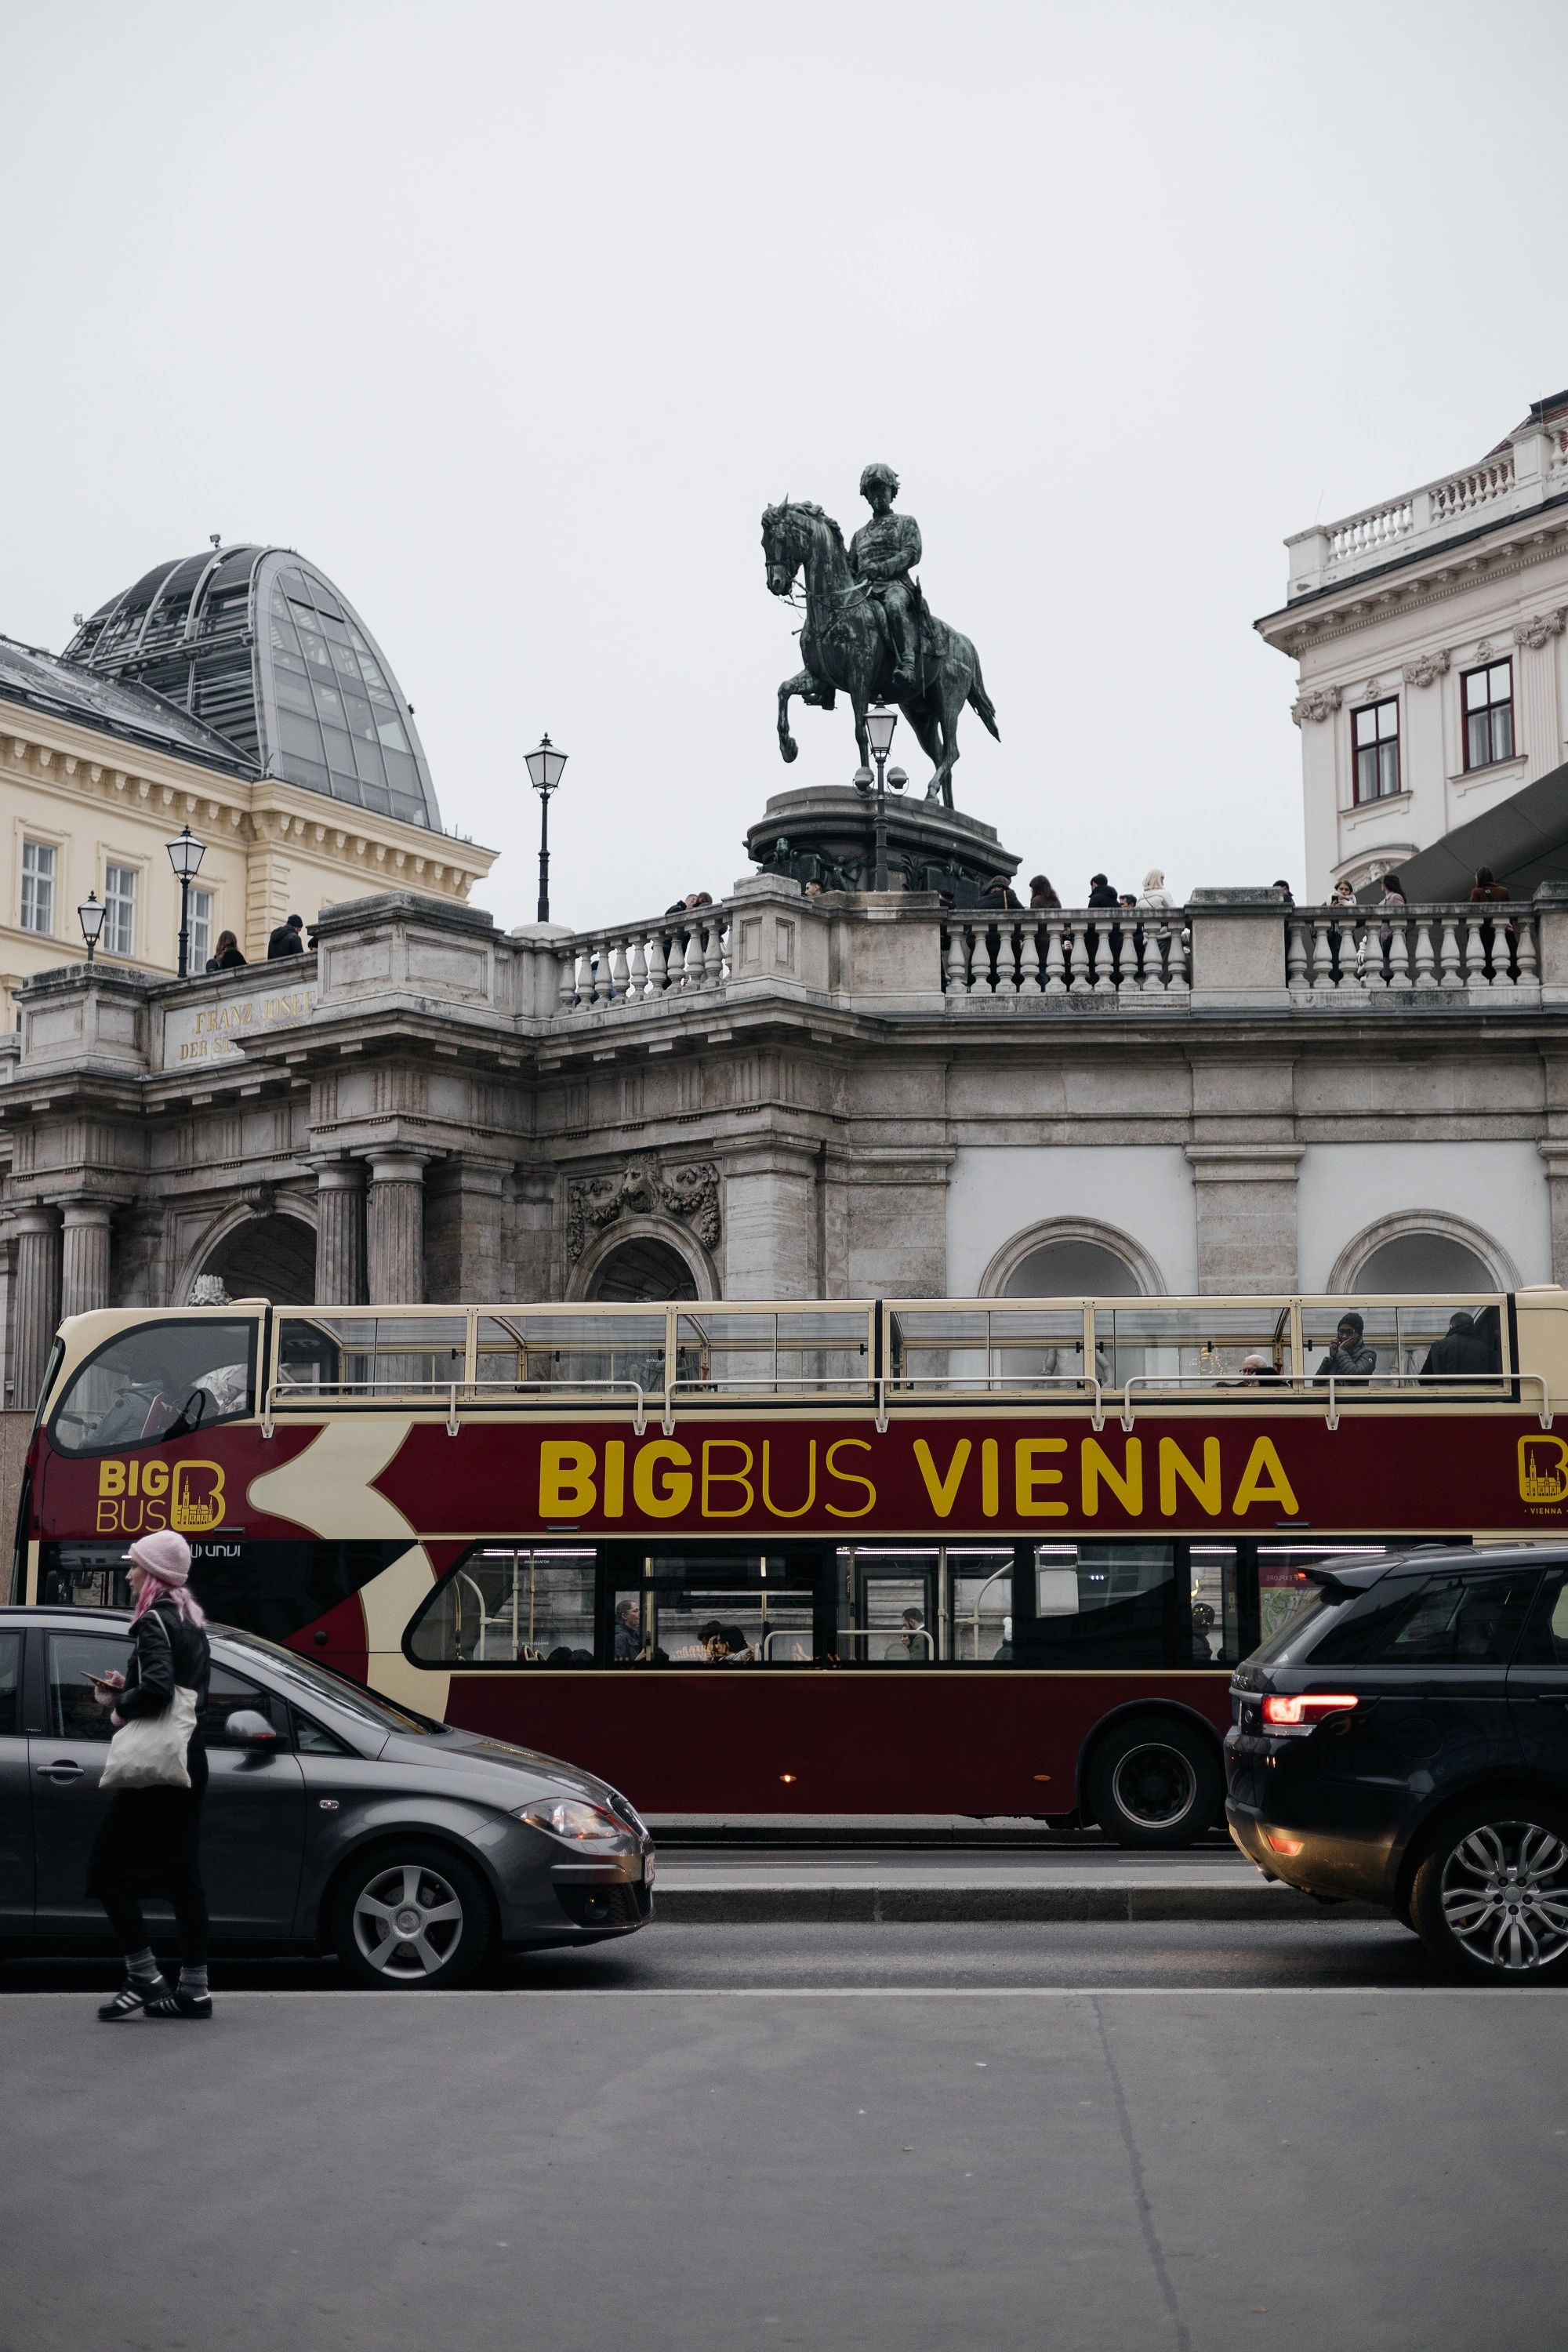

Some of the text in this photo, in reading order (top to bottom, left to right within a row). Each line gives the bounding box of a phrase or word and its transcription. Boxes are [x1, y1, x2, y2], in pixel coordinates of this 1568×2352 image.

[195, 990, 315, 1035] FRANZ JOSEF
[180, 1040, 208, 1060] DER
[99, 1460, 169, 1497] BIG
[913, 1436, 1300, 1518] VIENNA
[96, 1499, 167, 1532] BUS
